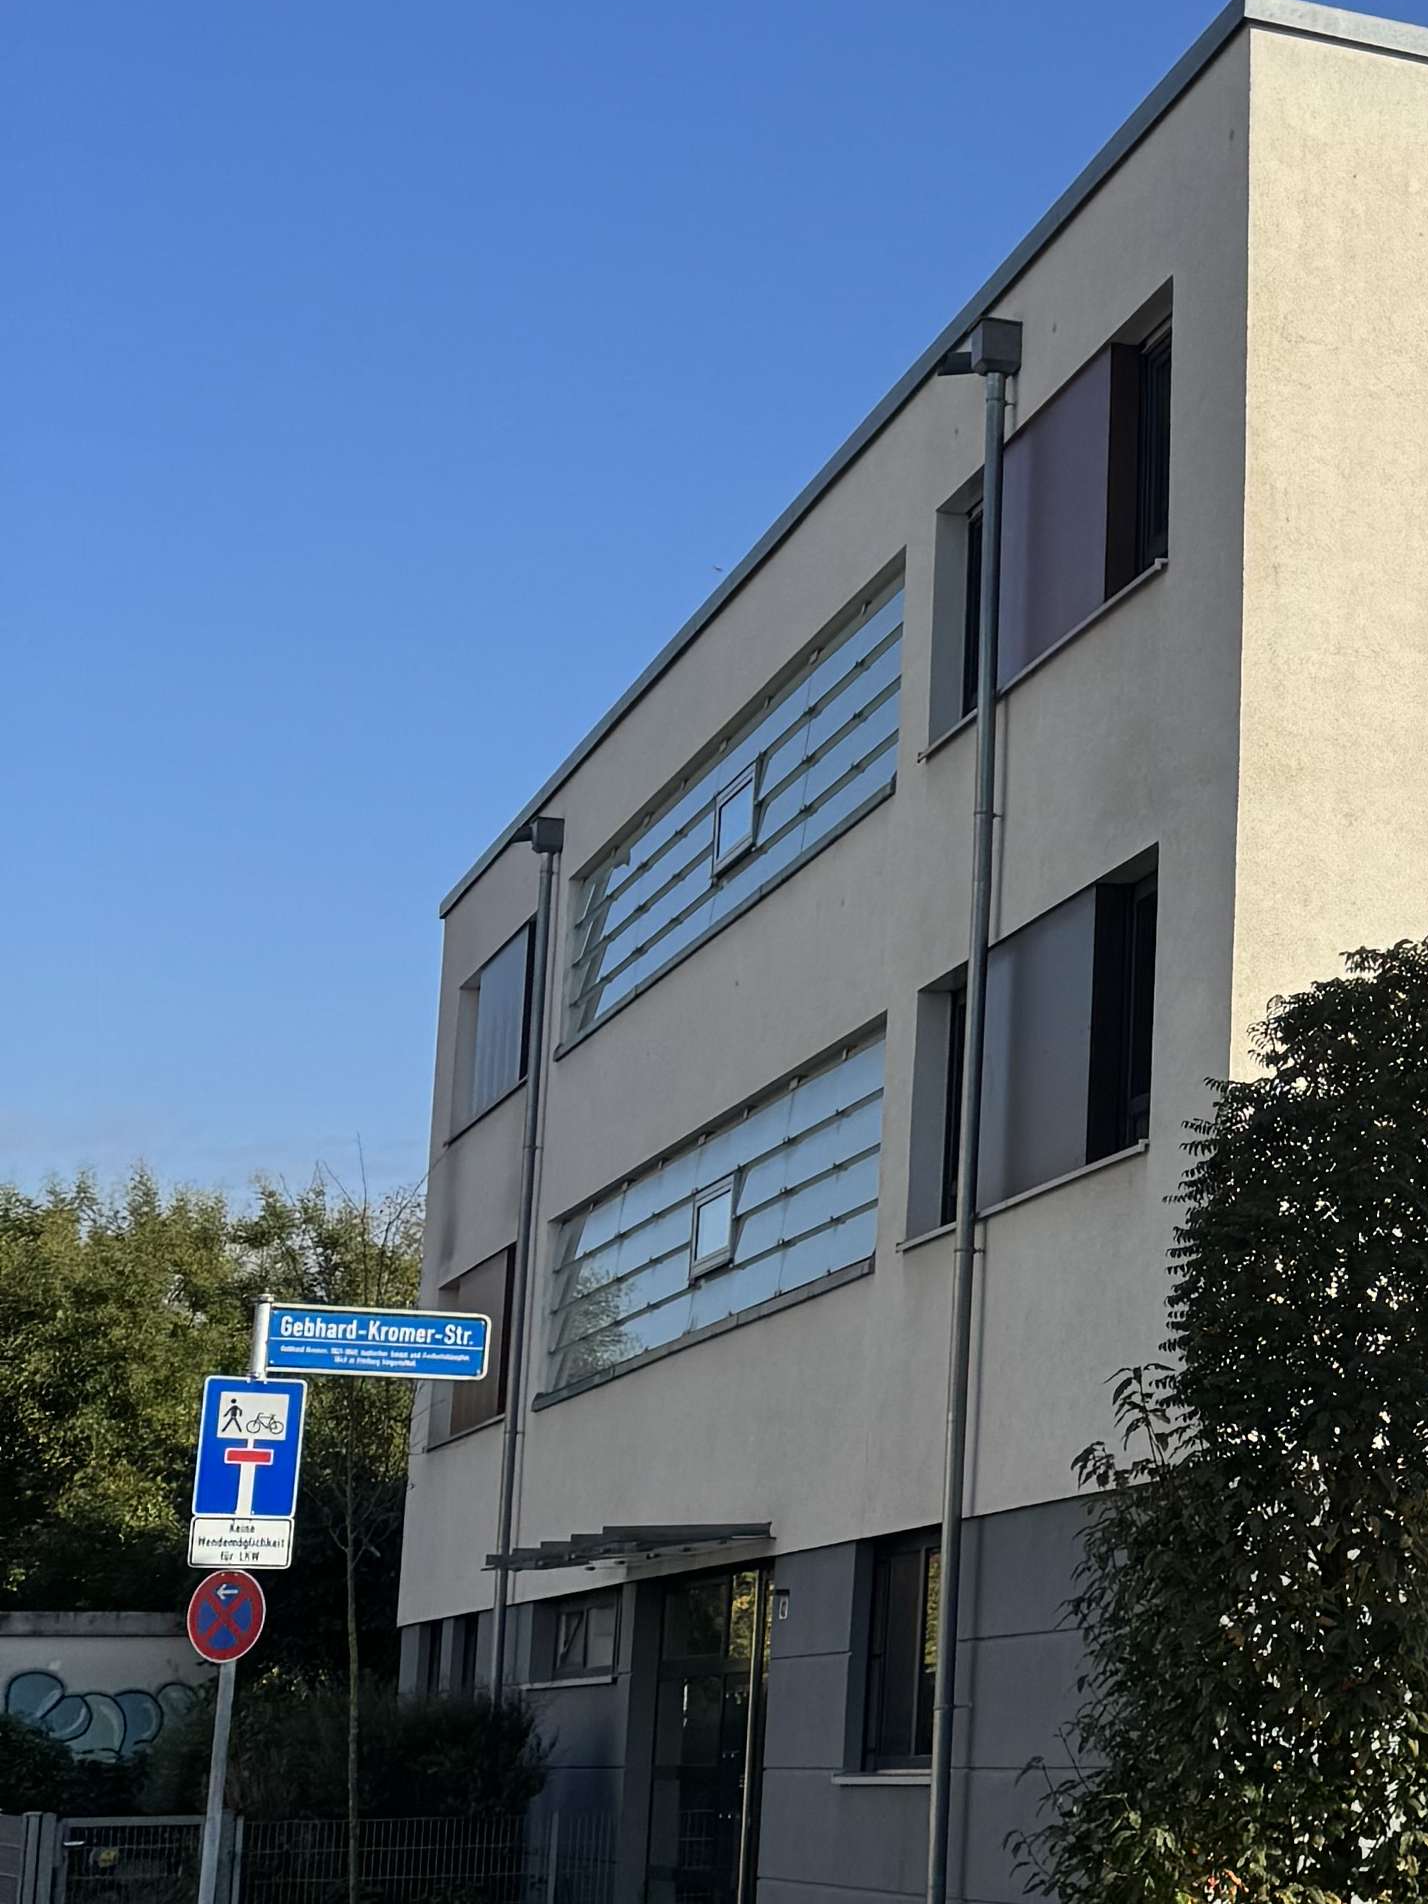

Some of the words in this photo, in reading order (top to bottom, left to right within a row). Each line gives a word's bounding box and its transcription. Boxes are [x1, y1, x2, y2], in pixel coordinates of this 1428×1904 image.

[280, 1315, 474, 1345] Gebhard-Kromer-Str.
[229, 1523, 256, 1533] Keine
[220, 1551, 234, 1561] für
[240, 1551, 260, 1562] LKW
